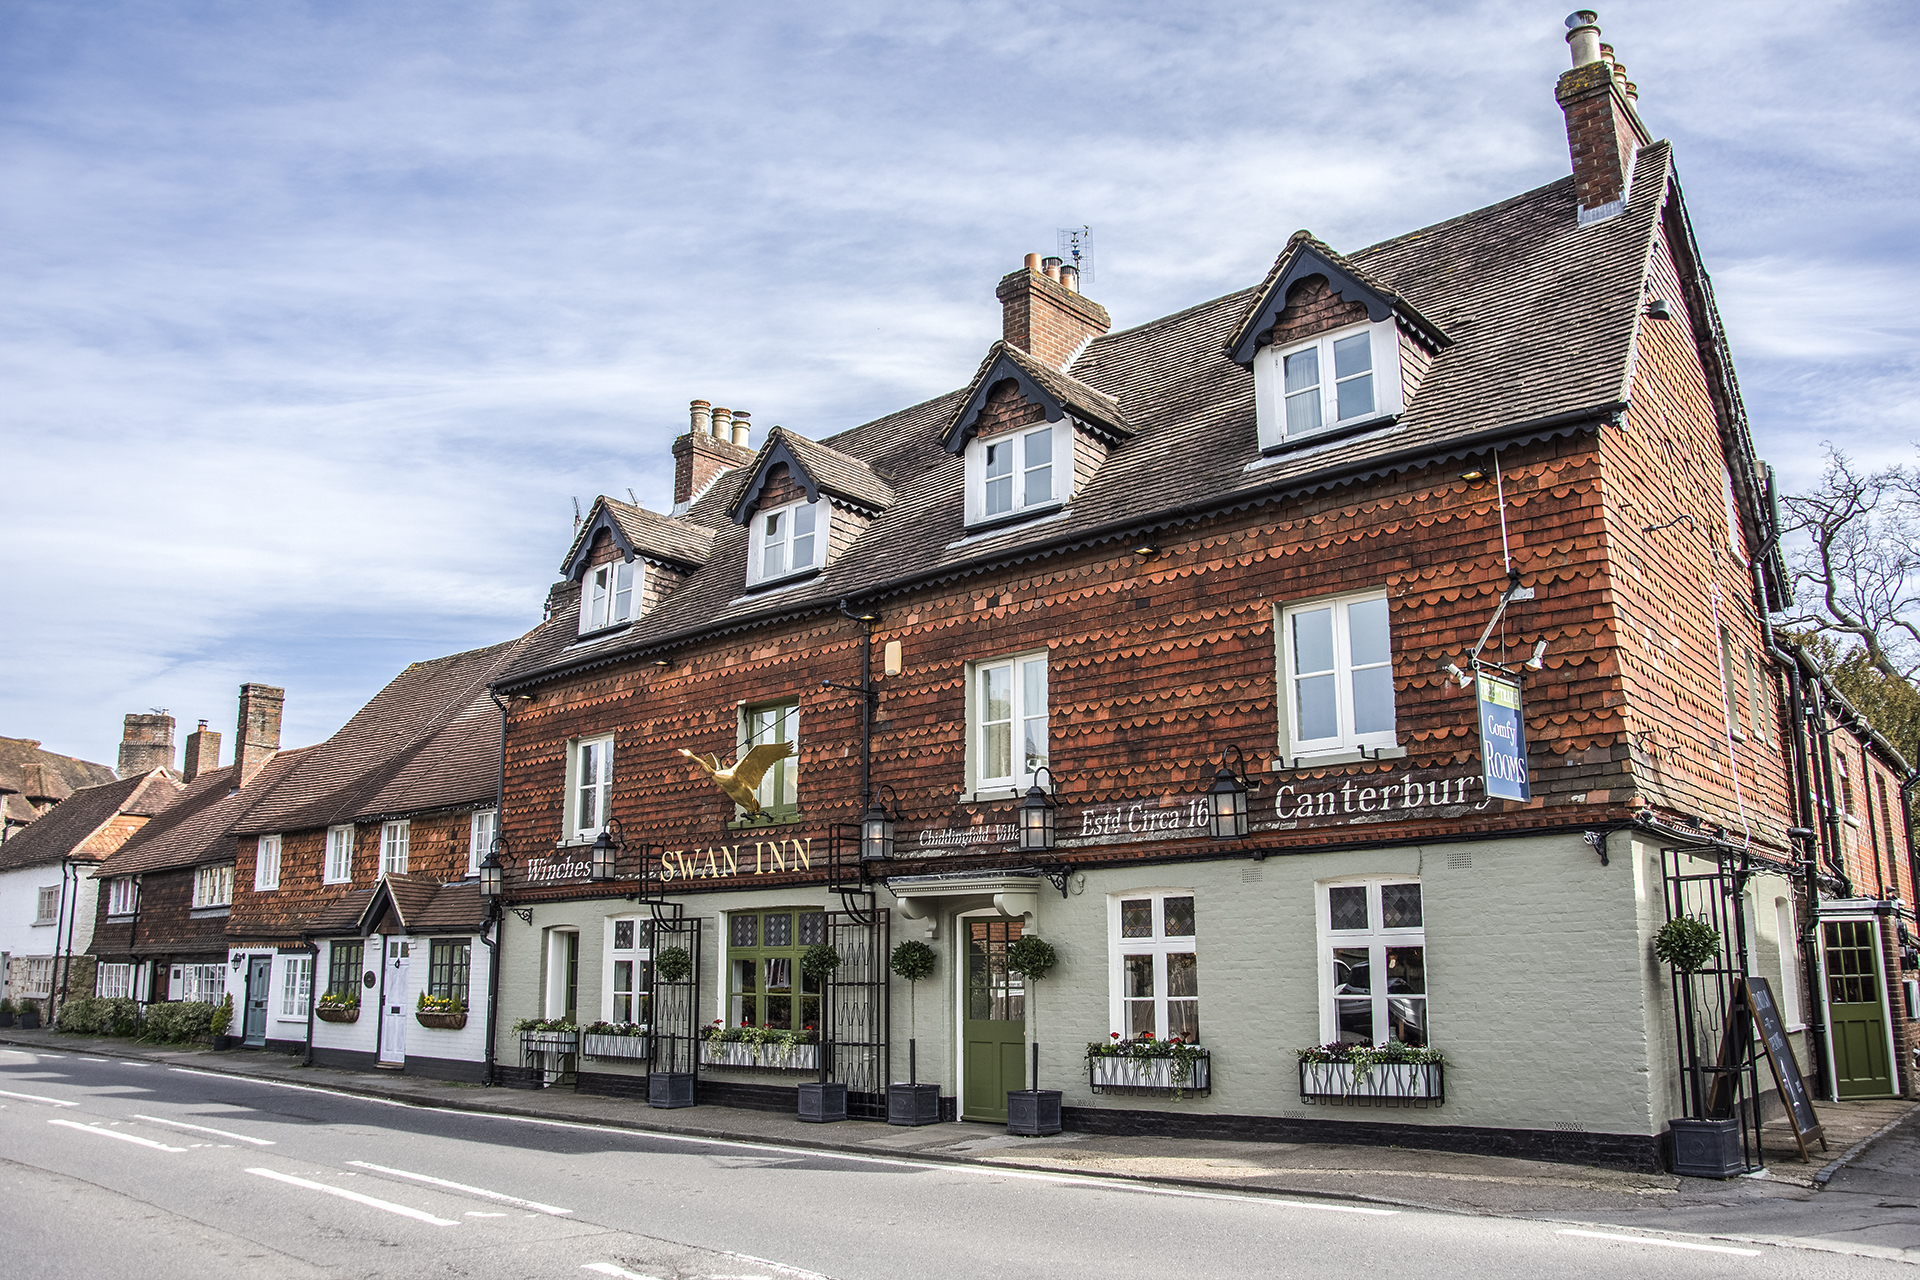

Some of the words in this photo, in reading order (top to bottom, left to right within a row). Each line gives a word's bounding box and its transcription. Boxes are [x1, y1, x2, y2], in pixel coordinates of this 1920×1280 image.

[1488, 715, 1516, 746] Comfy
[1128, 805, 1180, 832] Circa
[920, 825, 990, 848] Chiddingfold
[660, 844, 740, 882] SWAN
[754, 837, 813, 875] INN
